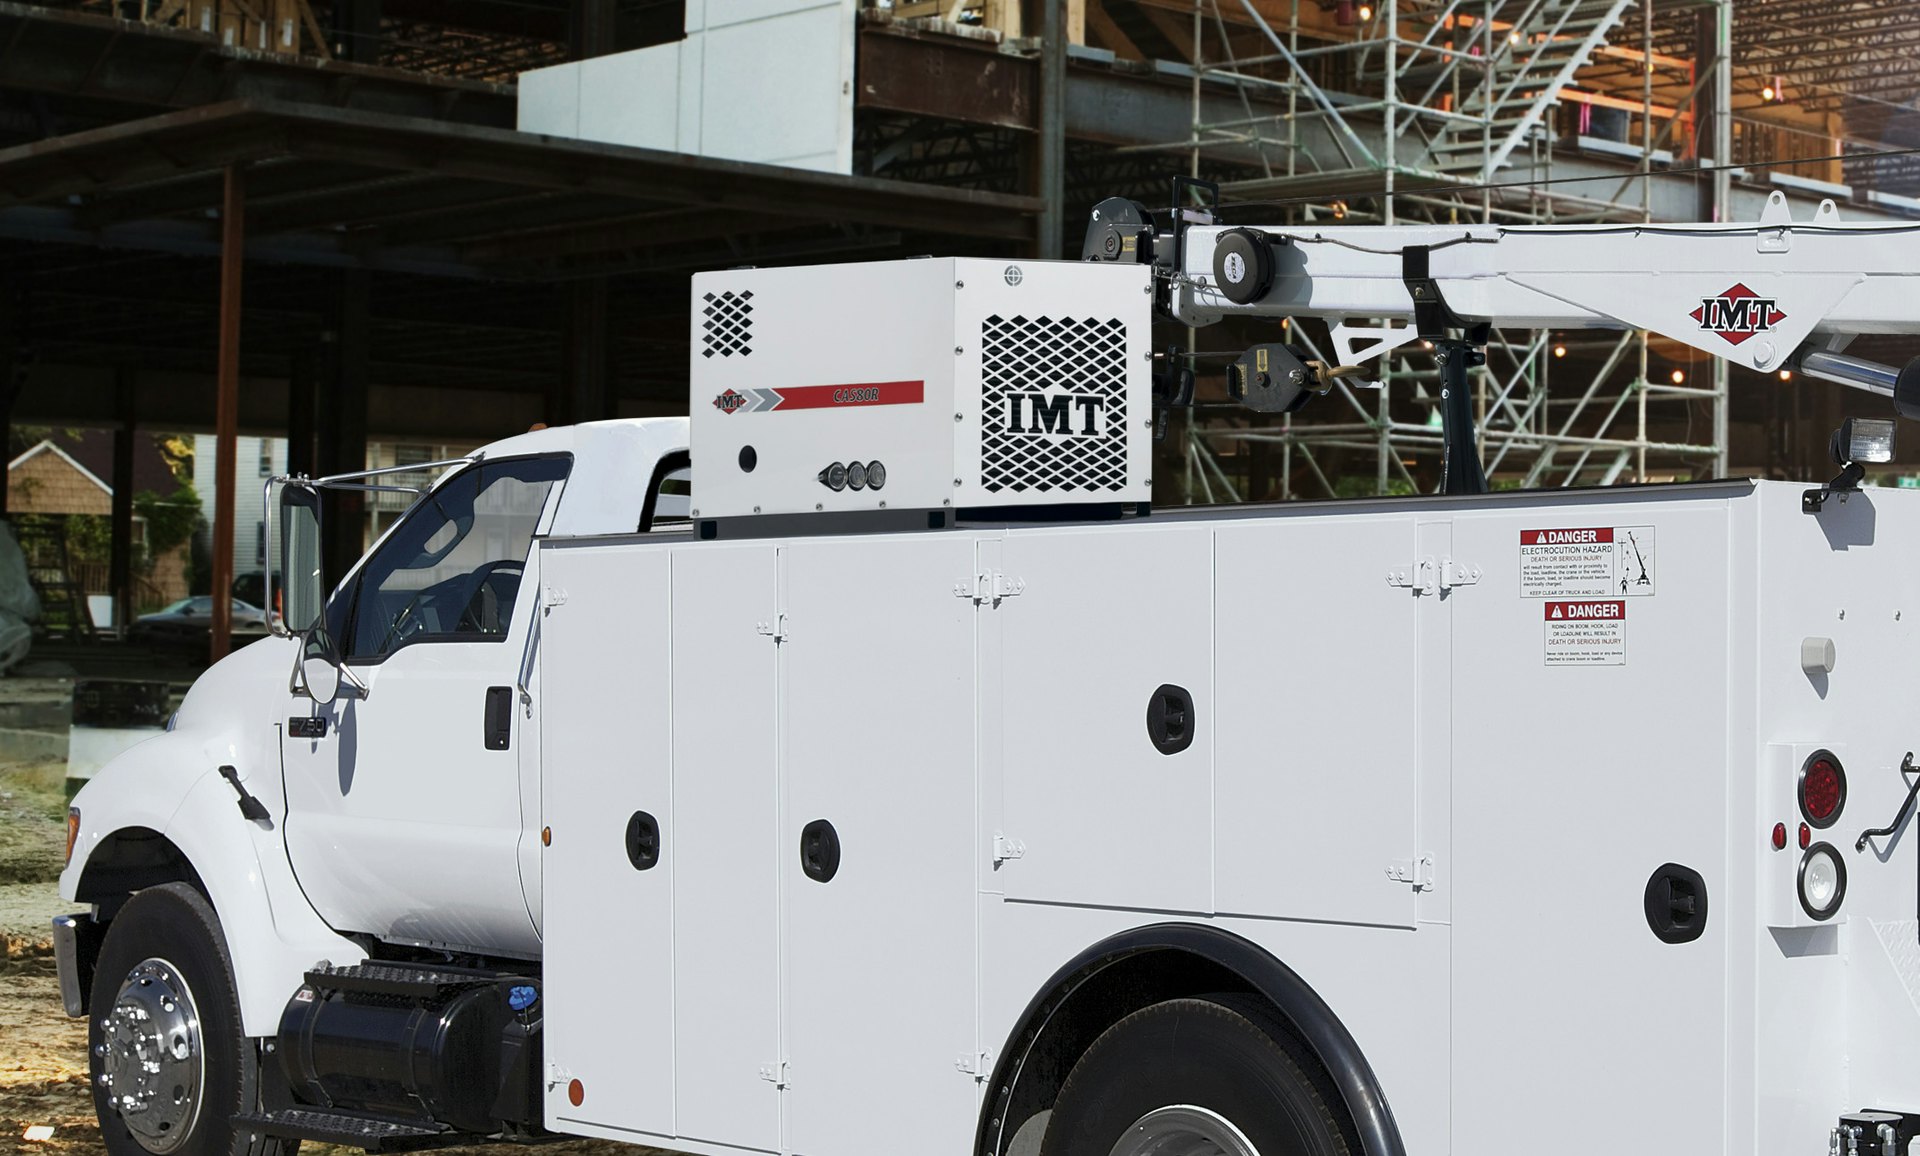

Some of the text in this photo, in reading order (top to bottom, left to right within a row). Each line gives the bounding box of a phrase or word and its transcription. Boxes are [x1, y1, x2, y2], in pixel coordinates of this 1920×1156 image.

[1700, 299, 1775, 331] IMT
[716, 395, 744, 409] IMT
[833, 388, 880, 402] CAS80R
[1006, 393, 1104, 436] IMT
[1548, 530, 1597, 543] DANGER
[1522, 546, 1580, 555] ELECTROCUTION
[1568, 604, 1618, 618] DANGER
